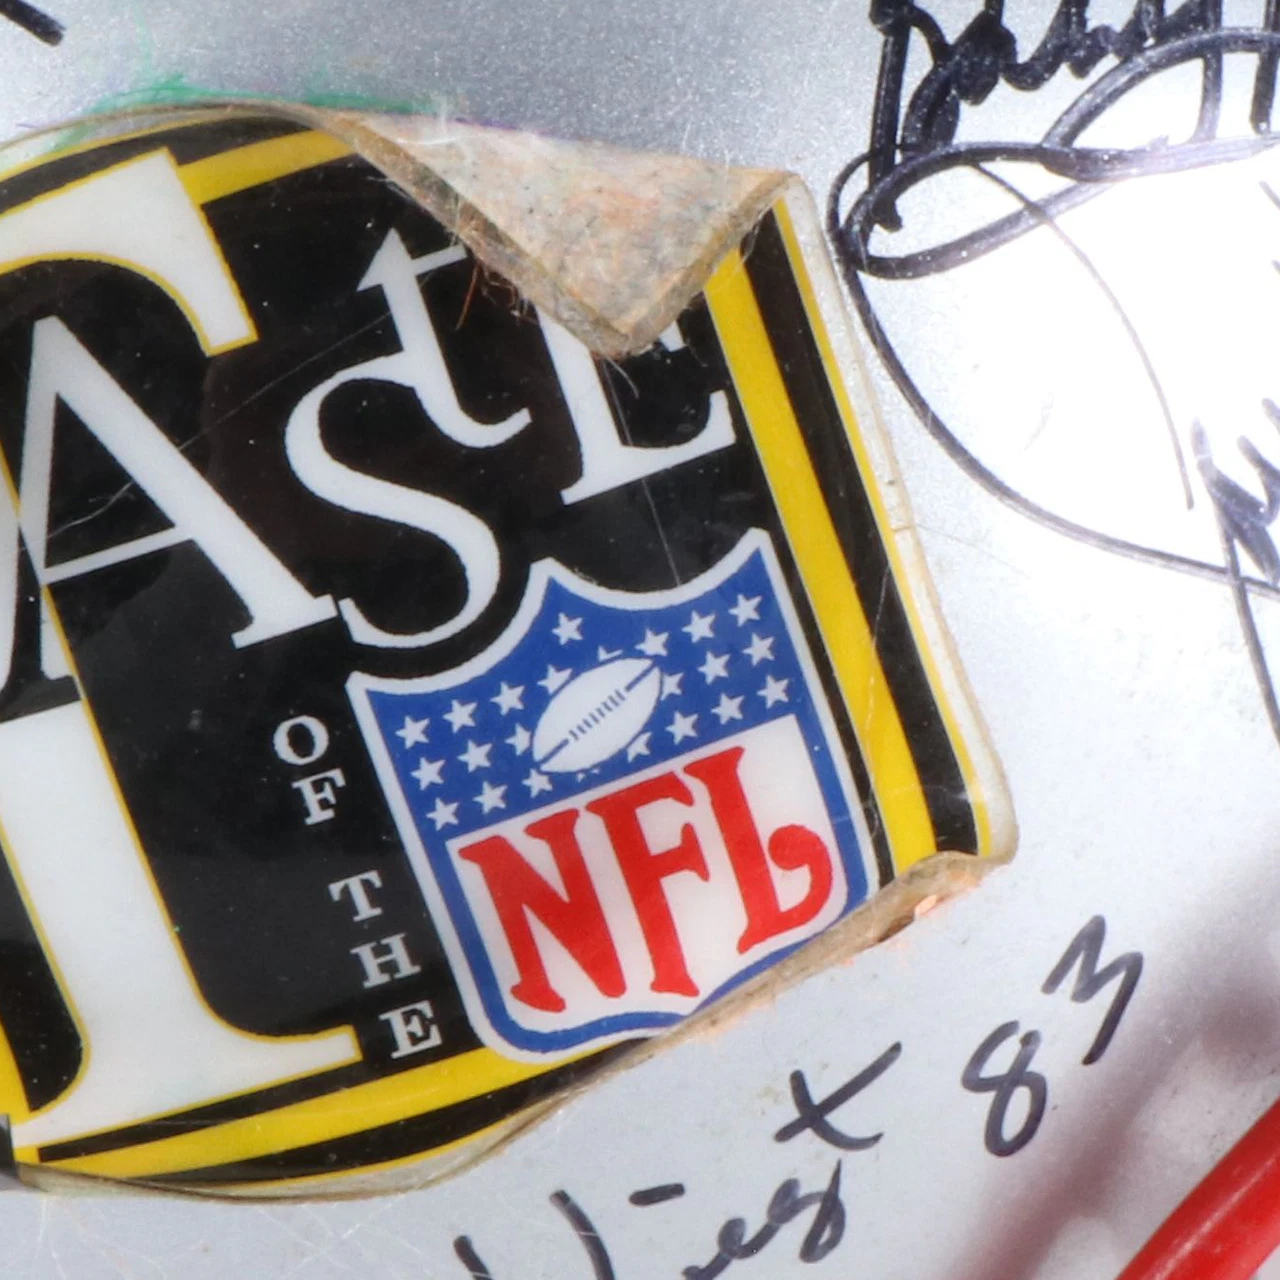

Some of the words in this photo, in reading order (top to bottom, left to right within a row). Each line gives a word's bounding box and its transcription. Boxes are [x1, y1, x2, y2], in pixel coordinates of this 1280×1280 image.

[272, 713, 346, 826] OF
[330, 870, 442, 1061] THE
[458, 745, 835, 1015] NFL
[959, 914, 1147, 1158] 83
